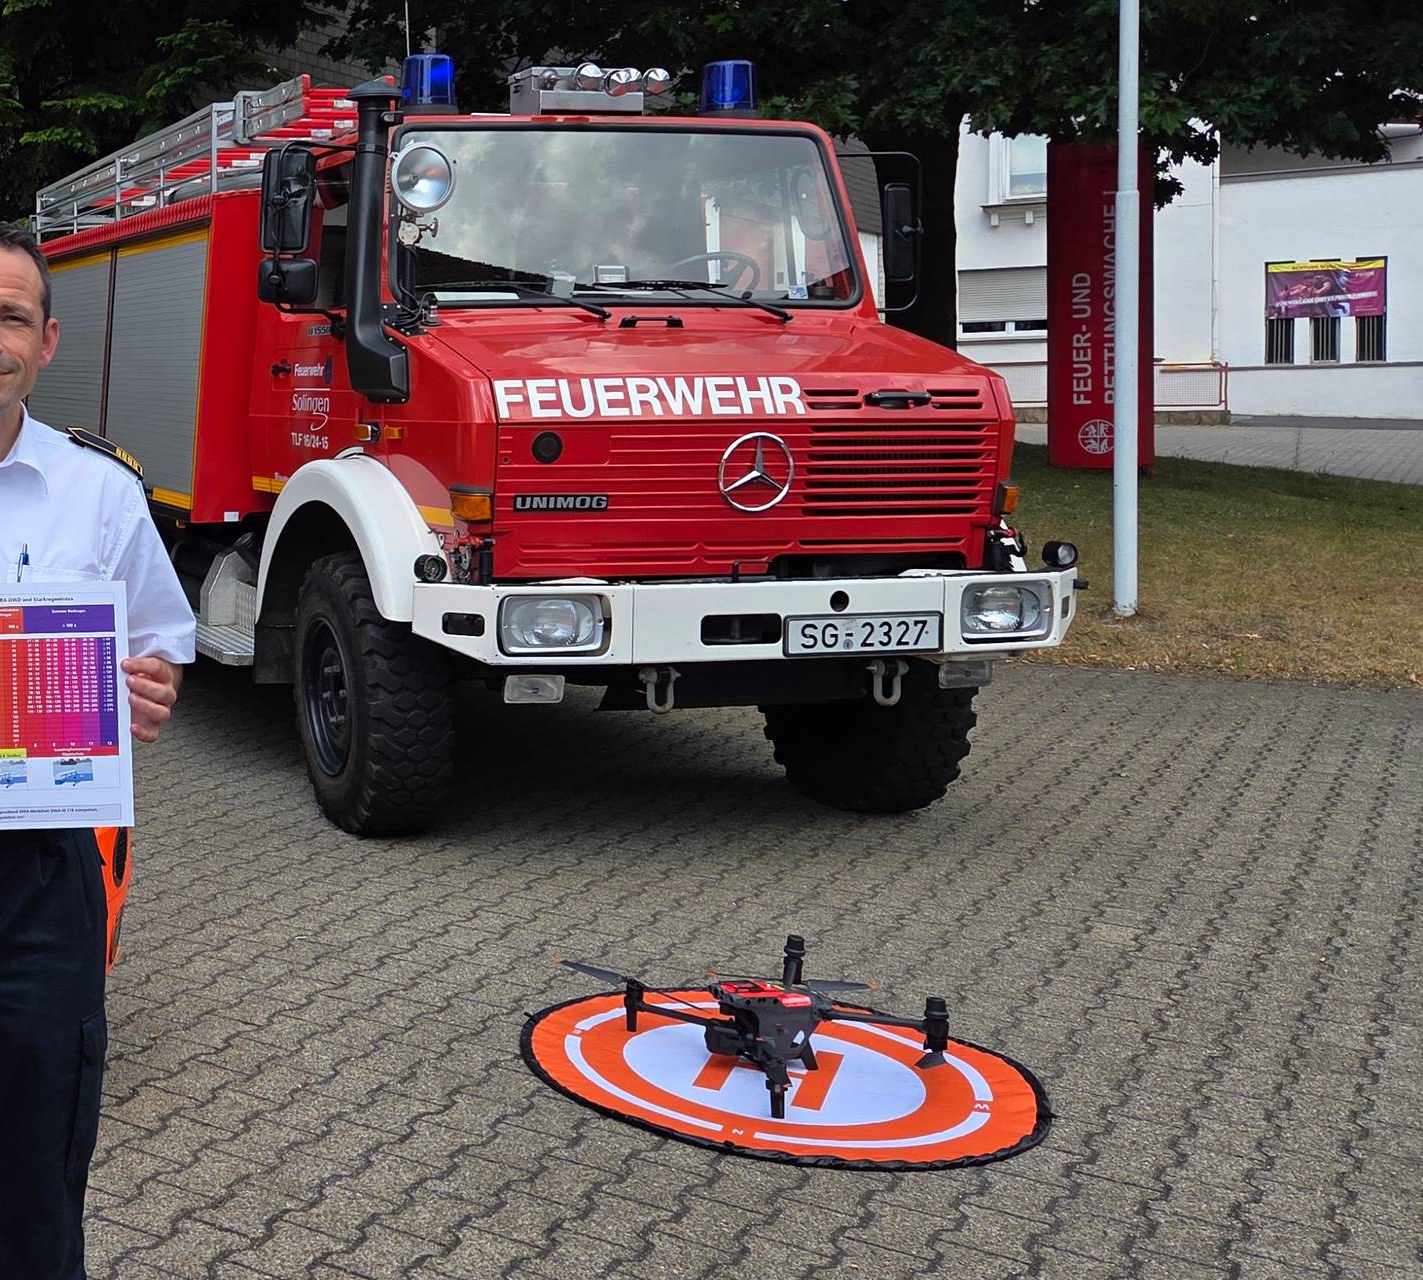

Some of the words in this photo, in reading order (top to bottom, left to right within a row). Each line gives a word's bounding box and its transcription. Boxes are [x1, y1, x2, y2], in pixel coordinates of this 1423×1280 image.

[1072, 272, 1092, 318] UND
[294, 363, 325, 377] Feuerwehr
[1072, 324, 1092, 405] FEUER-
[493, 376, 806, 418] FEUERWEHR
[291, 432, 302, 446] TLF
[516, 495, 608, 509] UNIMOG
